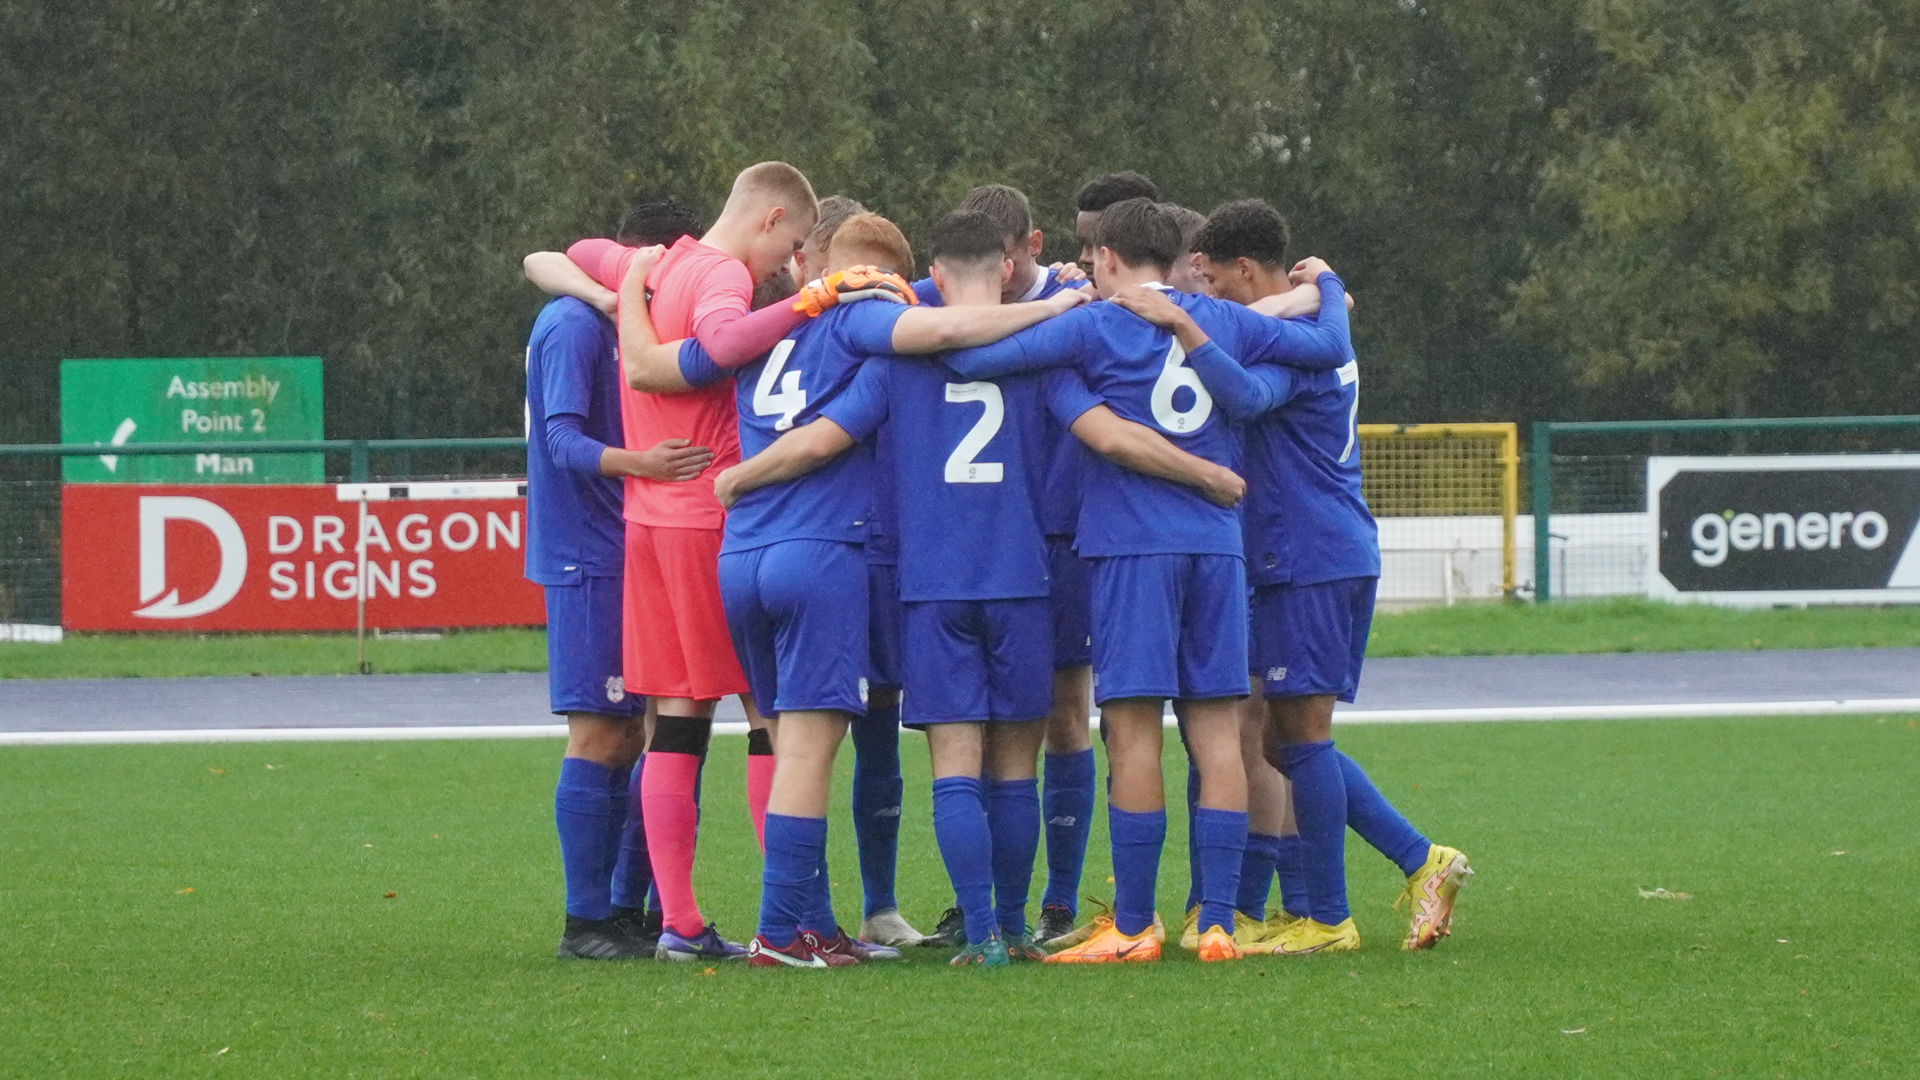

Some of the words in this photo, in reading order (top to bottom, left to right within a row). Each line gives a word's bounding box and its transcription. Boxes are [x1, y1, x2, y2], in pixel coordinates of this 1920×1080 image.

[166, 375, 281, 403] Assembly
[753, 339, 807, 432] 4
[1150, 334, 1213, 434] 6
[182, 409, 243, 433] Point
[250, 408, 267, 432] 2
[944, 381, 1005, 483] 2
[1335, 359, 1360, 463] 7
[195, 453, 254, 475] Man
[268, 510, 521, 554] DRAGON
[1690, 510, 1889, 568] genero
[268, 558, 437, 600] SIGNS
